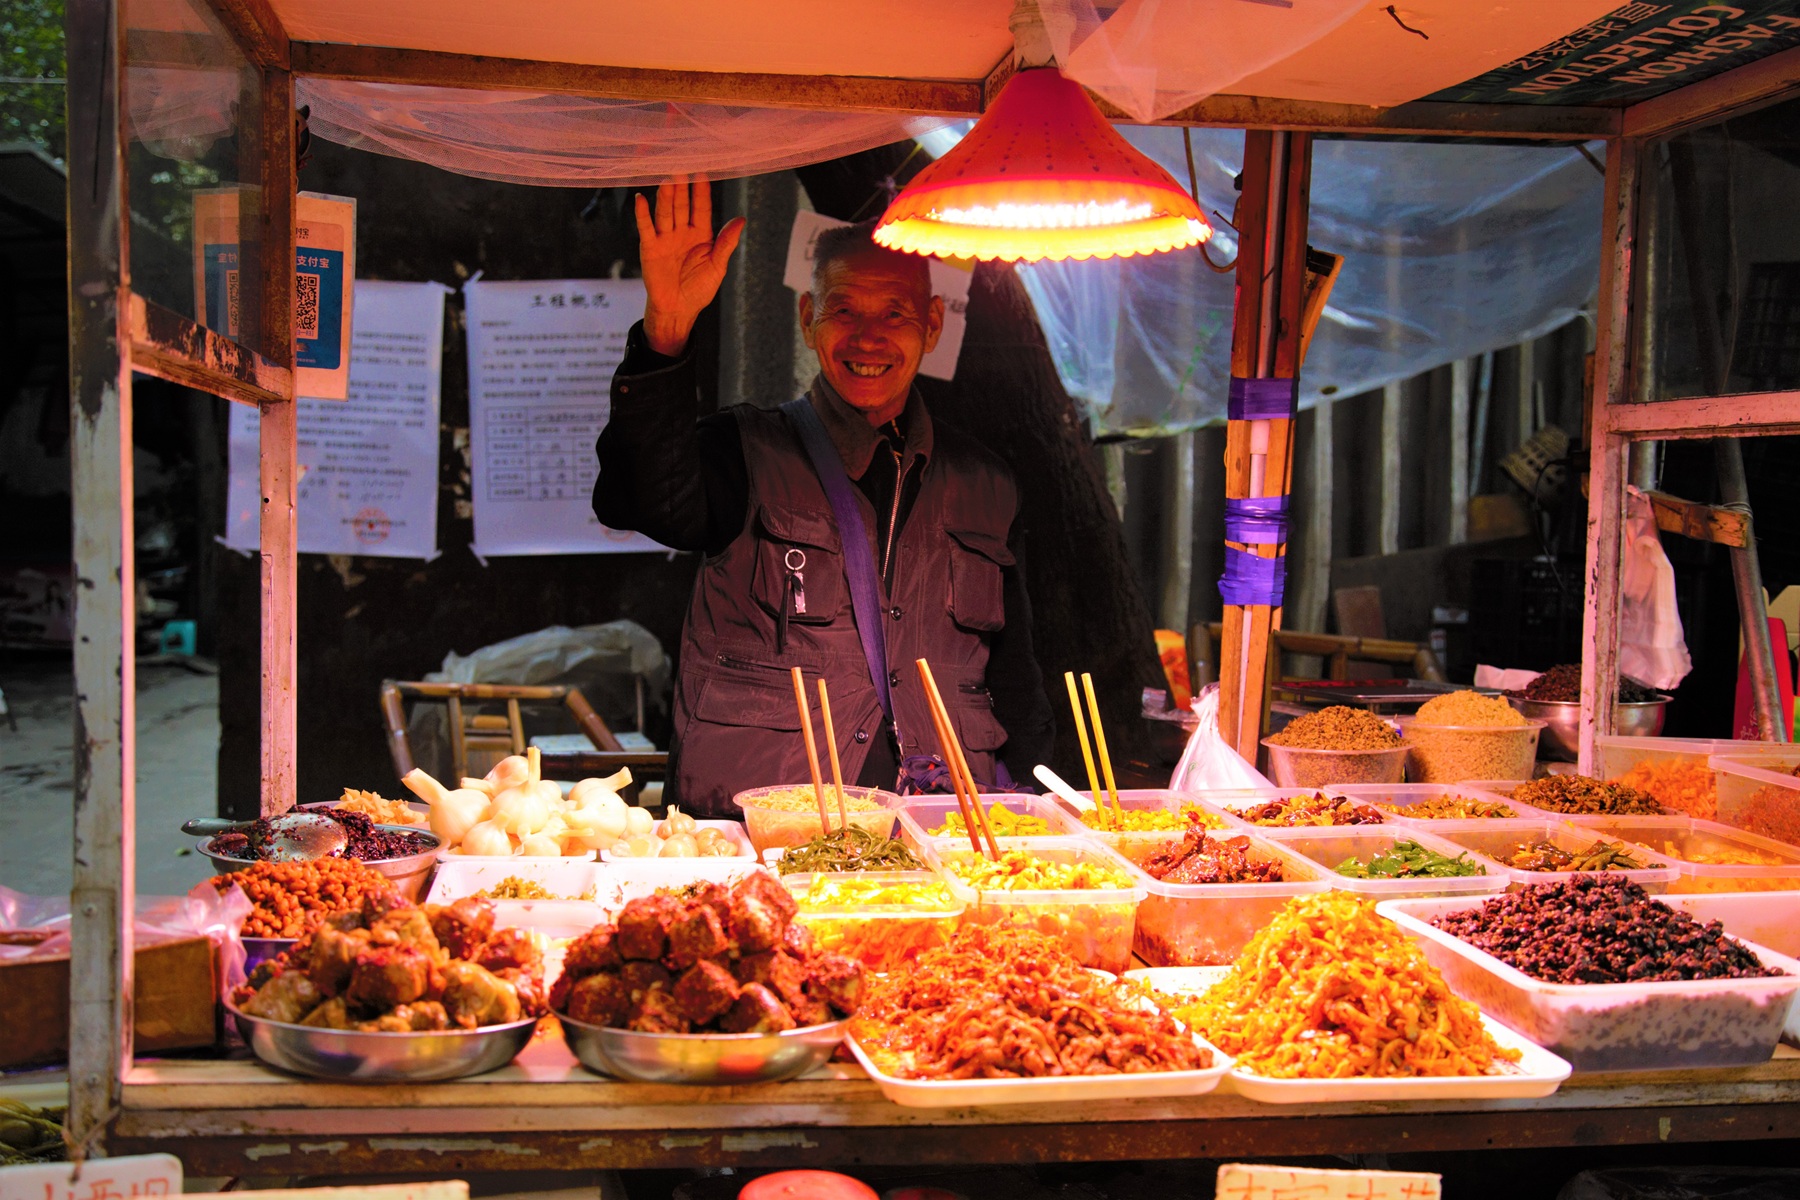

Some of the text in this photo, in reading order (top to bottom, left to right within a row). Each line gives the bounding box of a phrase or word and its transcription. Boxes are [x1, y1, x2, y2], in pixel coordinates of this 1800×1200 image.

[1507, 5, 1746, 95] COLLECTION
[1610, 14, 1800, 84] FASHION
[297, 255, 330, 269] 支付宝
